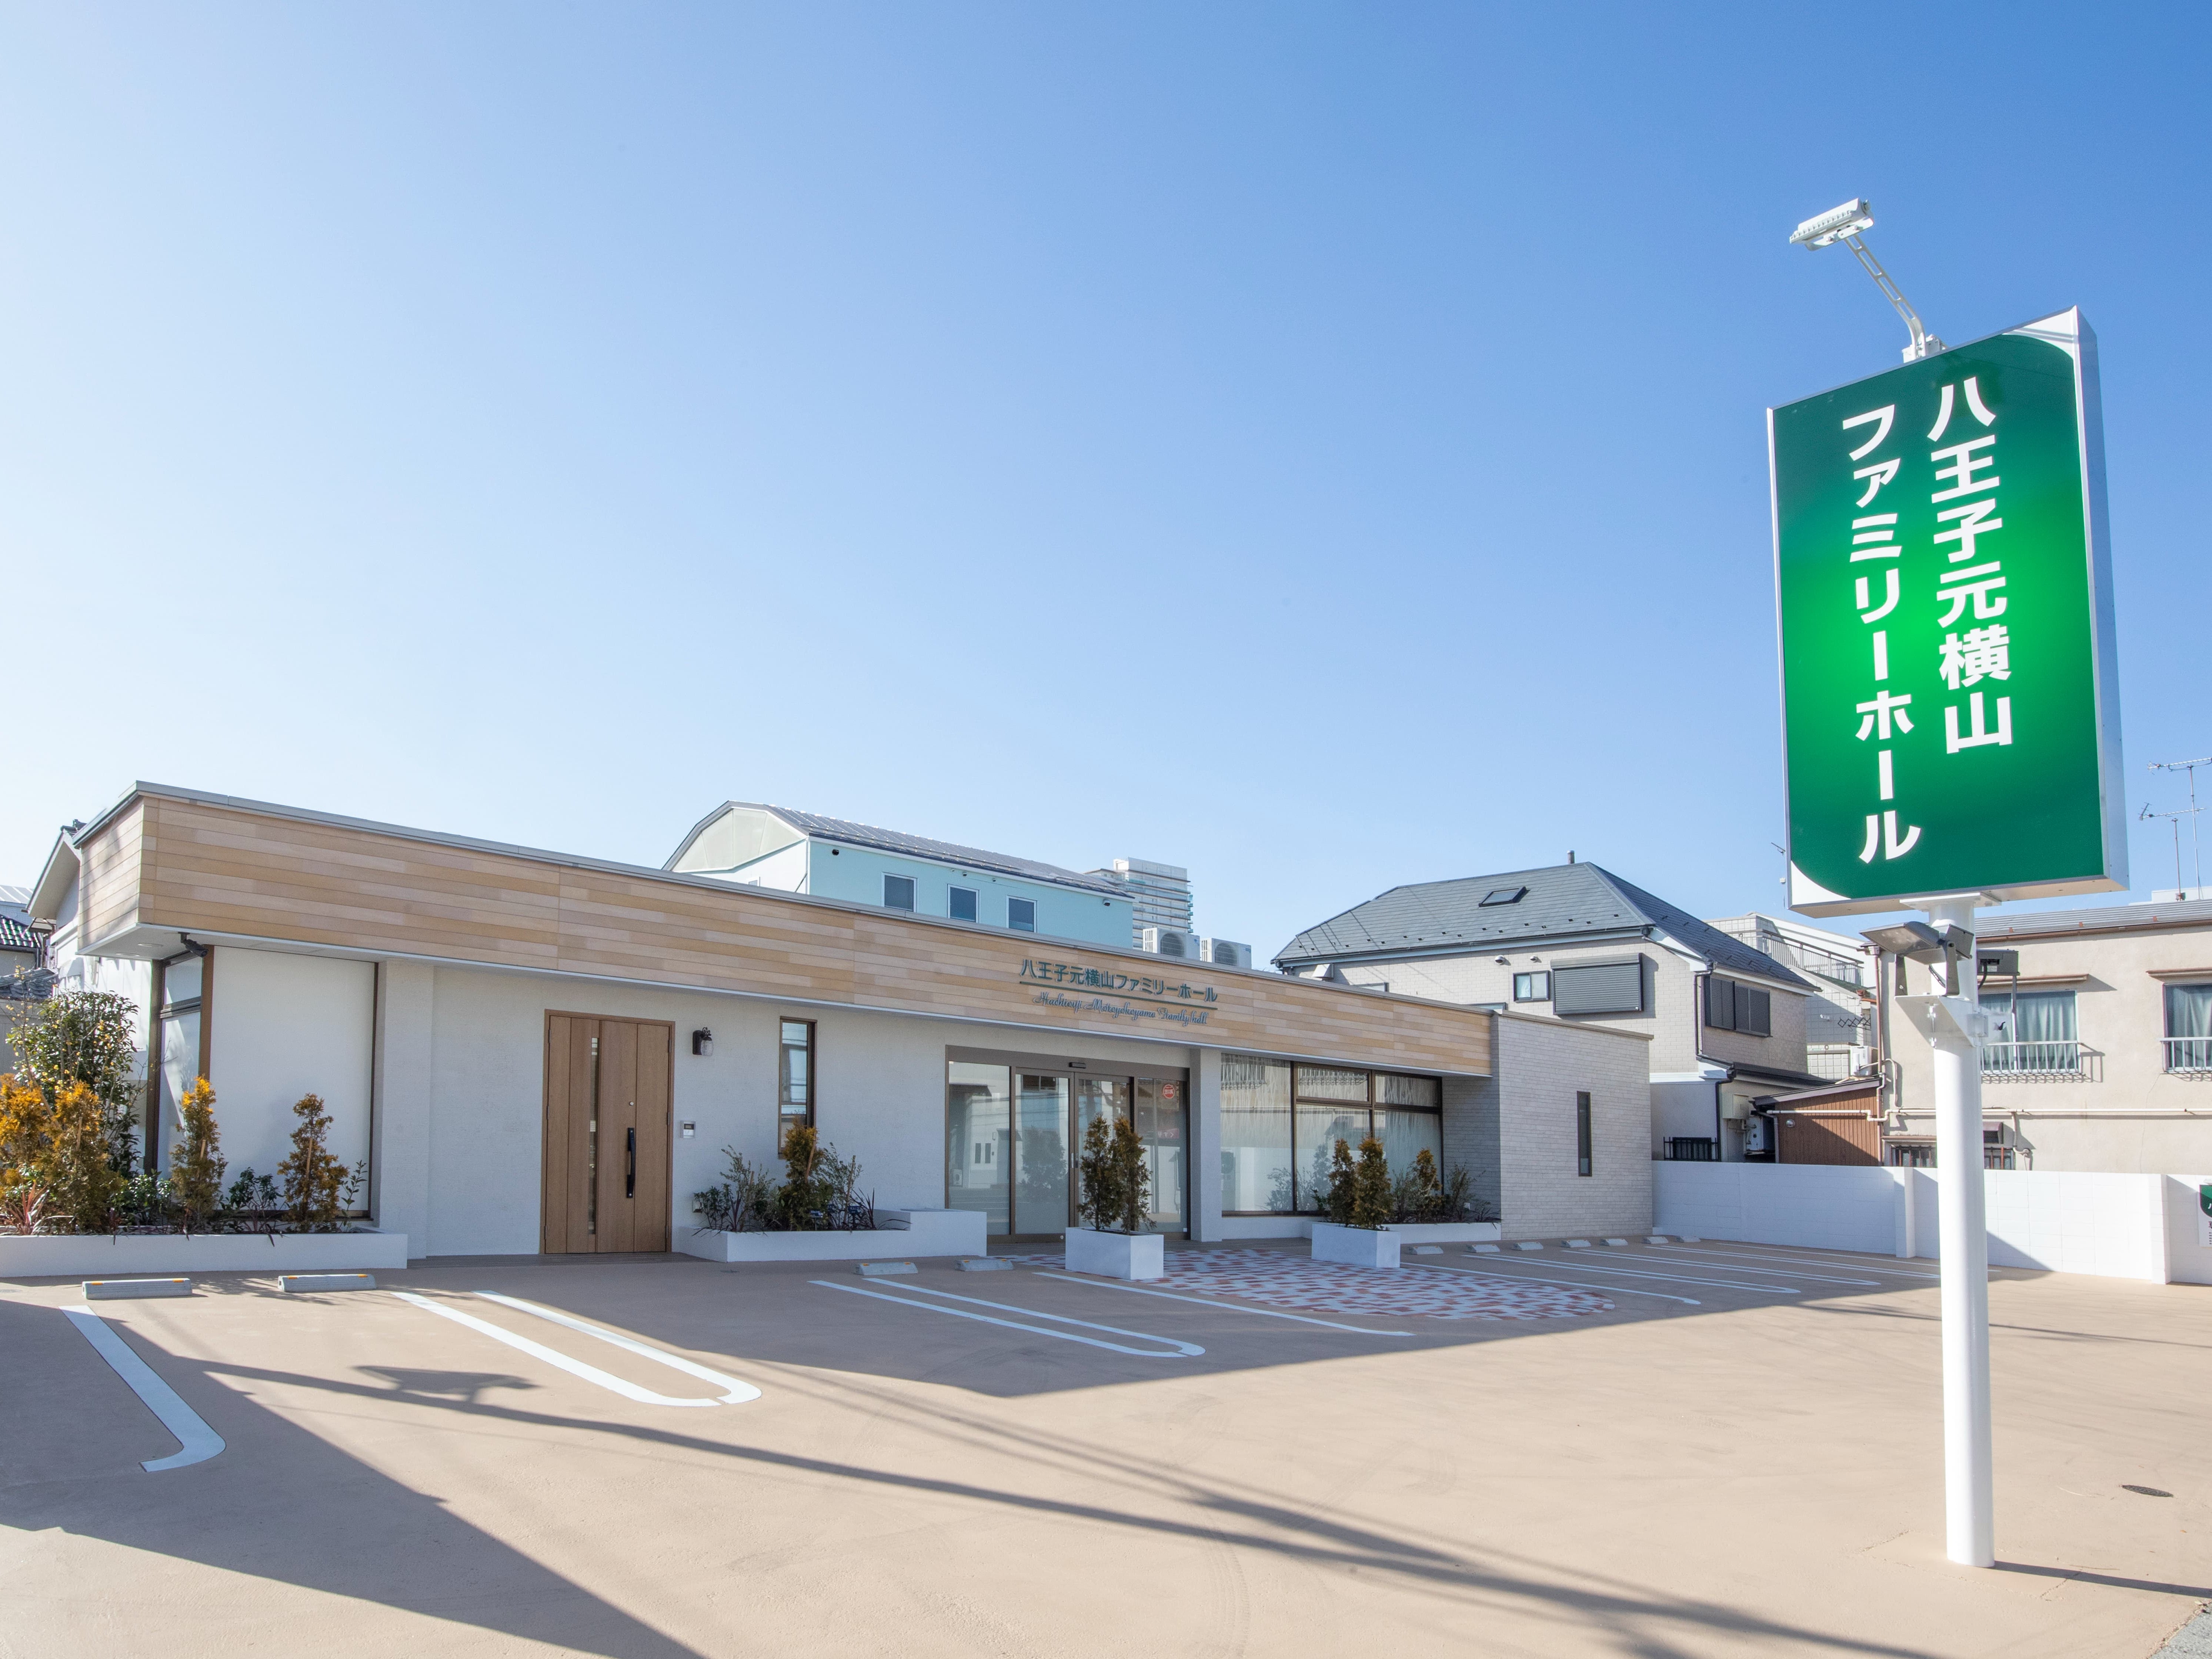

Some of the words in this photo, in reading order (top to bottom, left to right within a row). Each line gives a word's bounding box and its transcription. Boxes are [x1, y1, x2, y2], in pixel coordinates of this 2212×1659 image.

[1843, 405, 1921, 863] ファミリーホール
[1928, 377, 2012, 753] 八王子元横山
[1020, 959, 1218, 1002] 八王子元横山ファミリーホール
[1084, 998, 1156, 1021] Motoyokoyama
[1157, 1007, 1189, 1027] Family
[1190, 1010, 1209, 1024] hall
